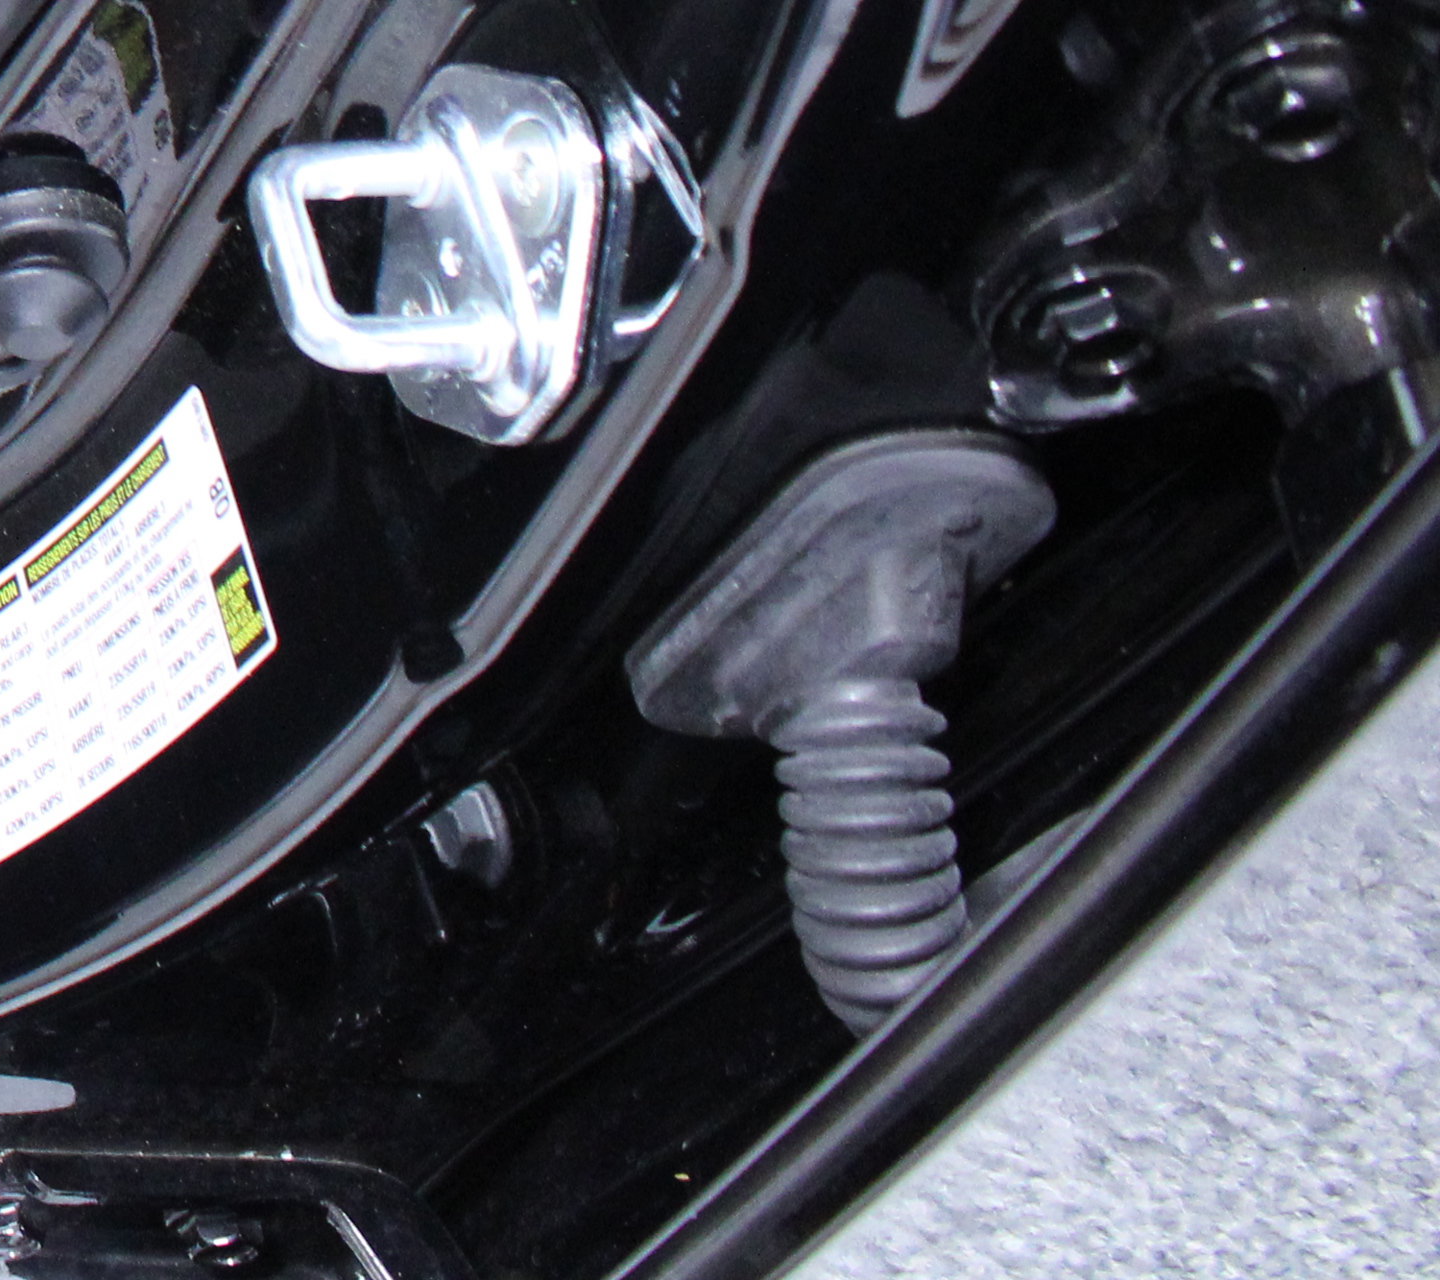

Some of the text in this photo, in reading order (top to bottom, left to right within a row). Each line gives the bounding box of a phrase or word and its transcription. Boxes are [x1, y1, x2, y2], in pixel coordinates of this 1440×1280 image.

[96, 611, 140, 656] DIMENSIONS
[10, 689, 43, 717] PRESSURE
[67, 691, 92, 719] AVANT
